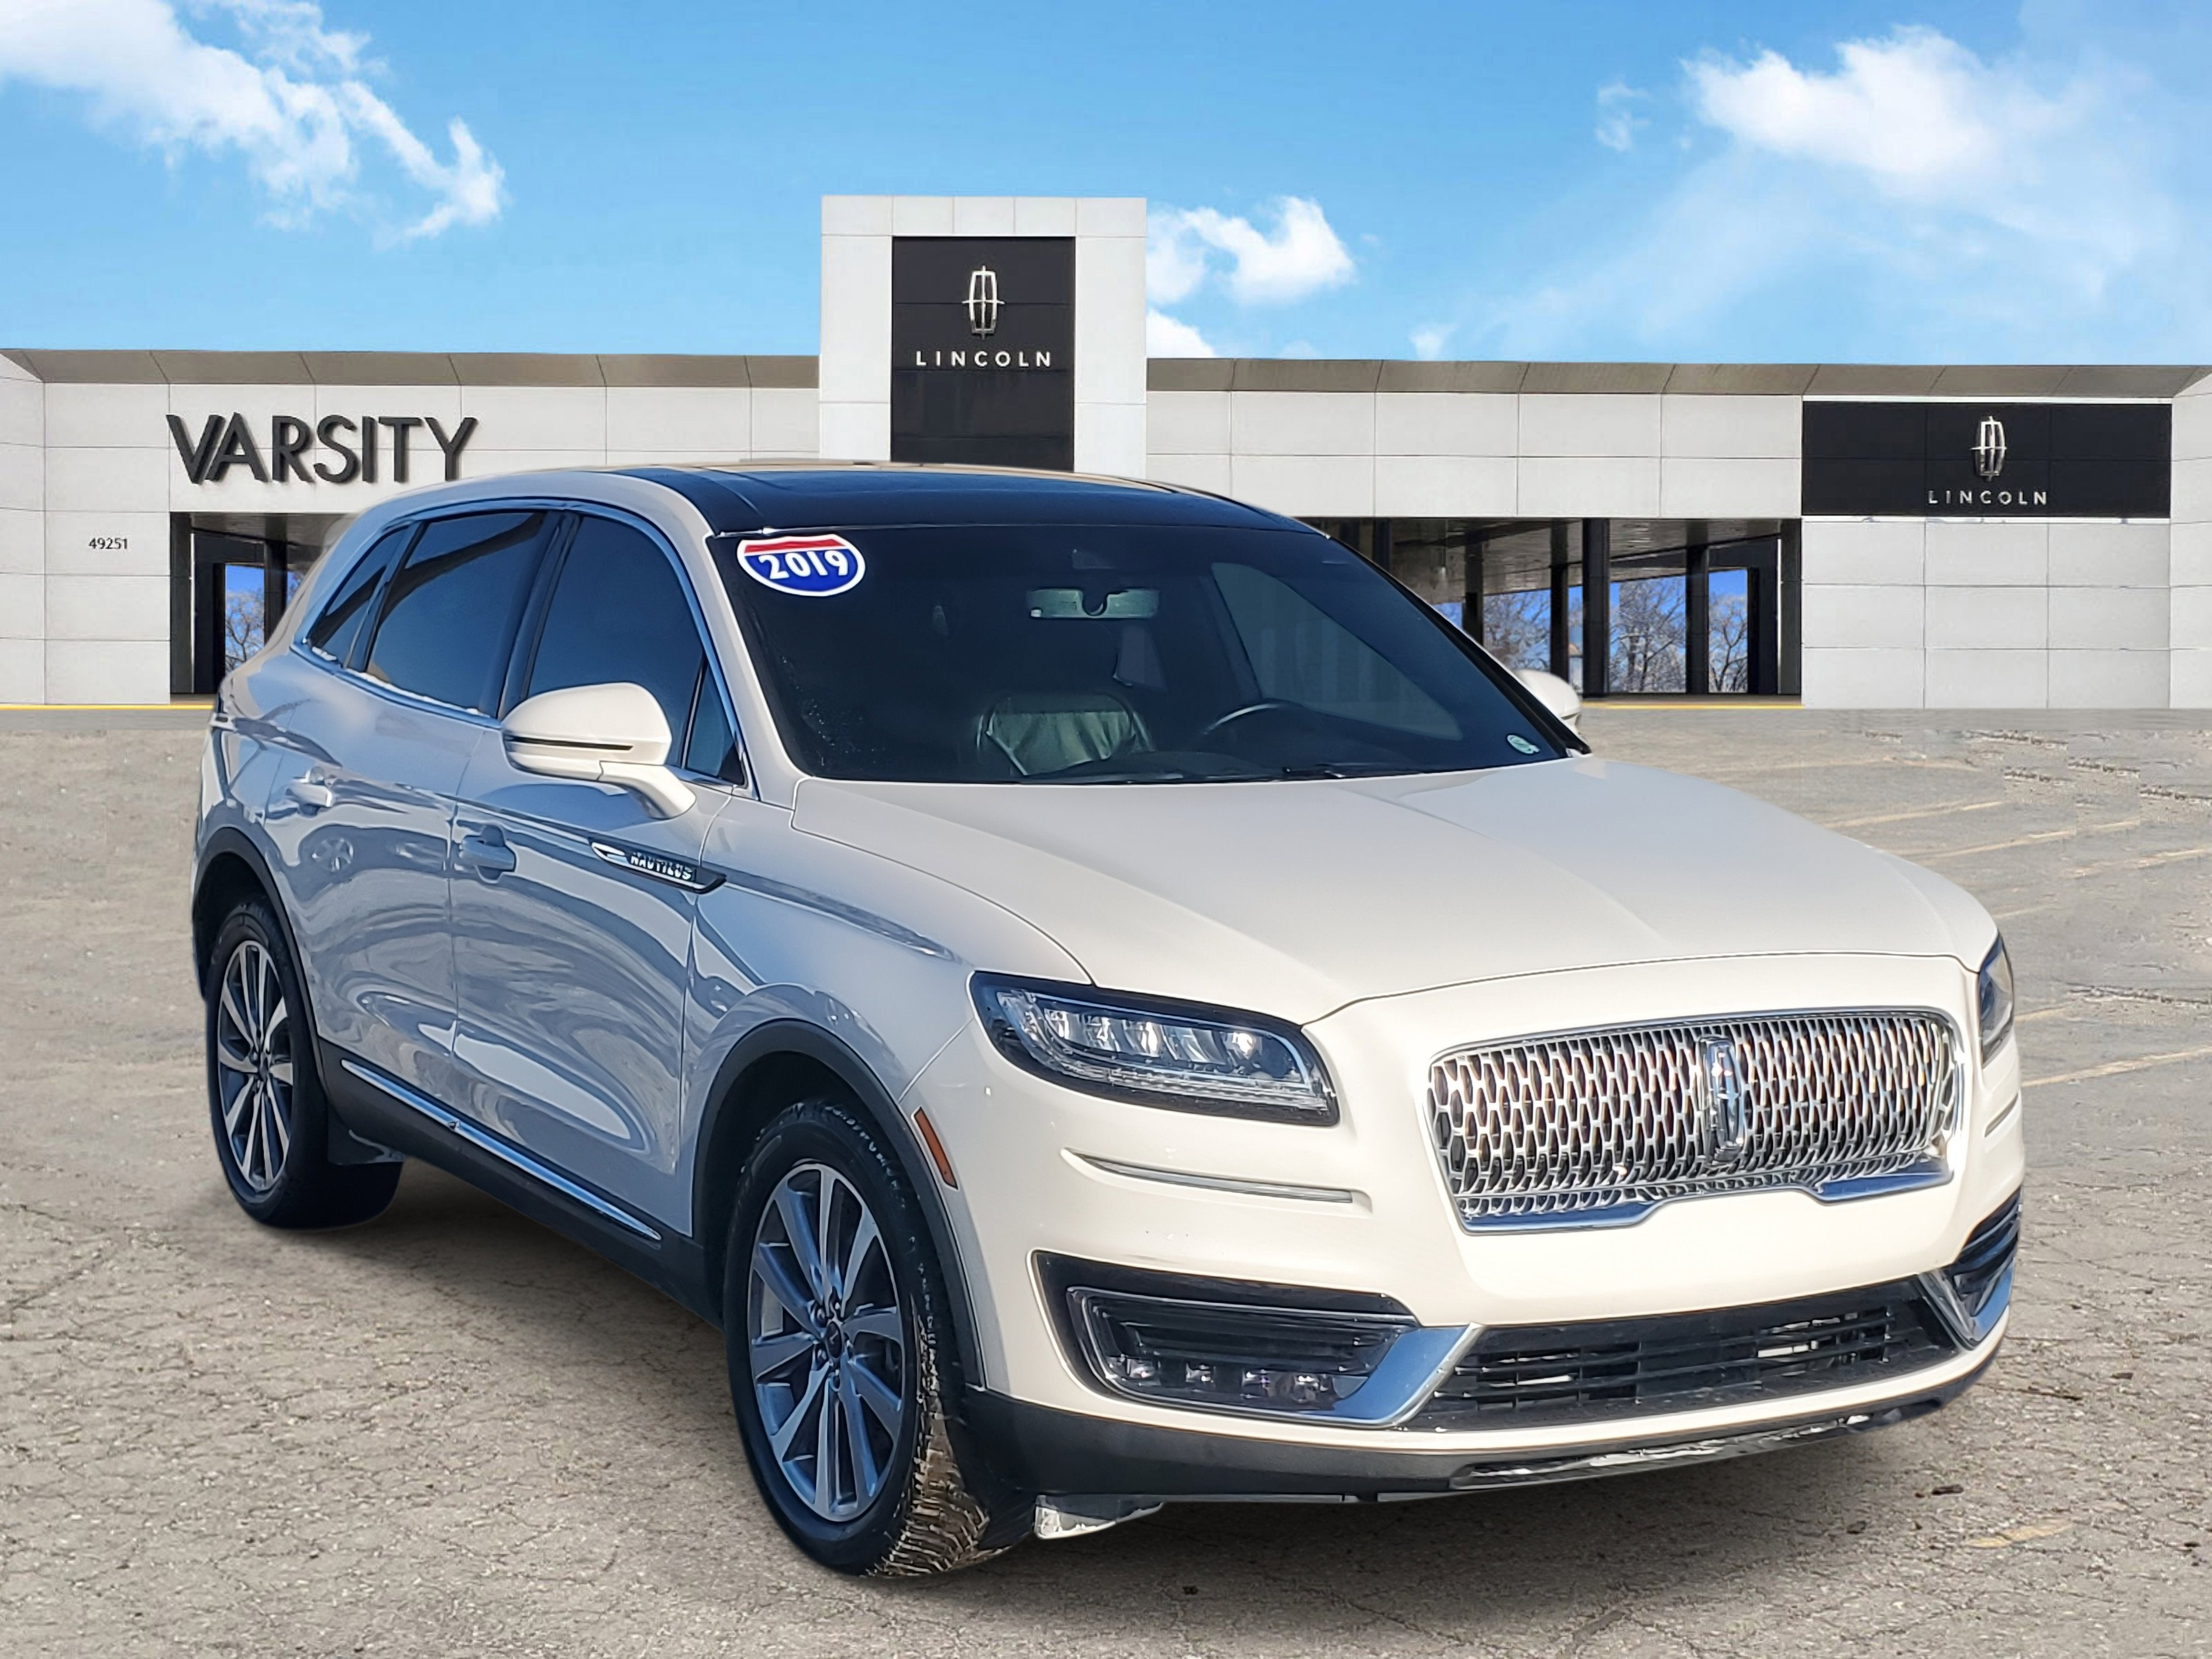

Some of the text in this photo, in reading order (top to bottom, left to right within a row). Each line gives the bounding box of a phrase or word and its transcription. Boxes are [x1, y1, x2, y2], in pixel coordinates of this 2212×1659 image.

[916, 351, 1051, 367] LINCOLN
[166, 412, 478, 484] VARSITY
[1928, 490, 2048, 505] LINCOLN
[88, 538, 128, 549] 49251
[758, 550, 848, 579] 2019
[630, 852, 693, 880] NAUTILUS
